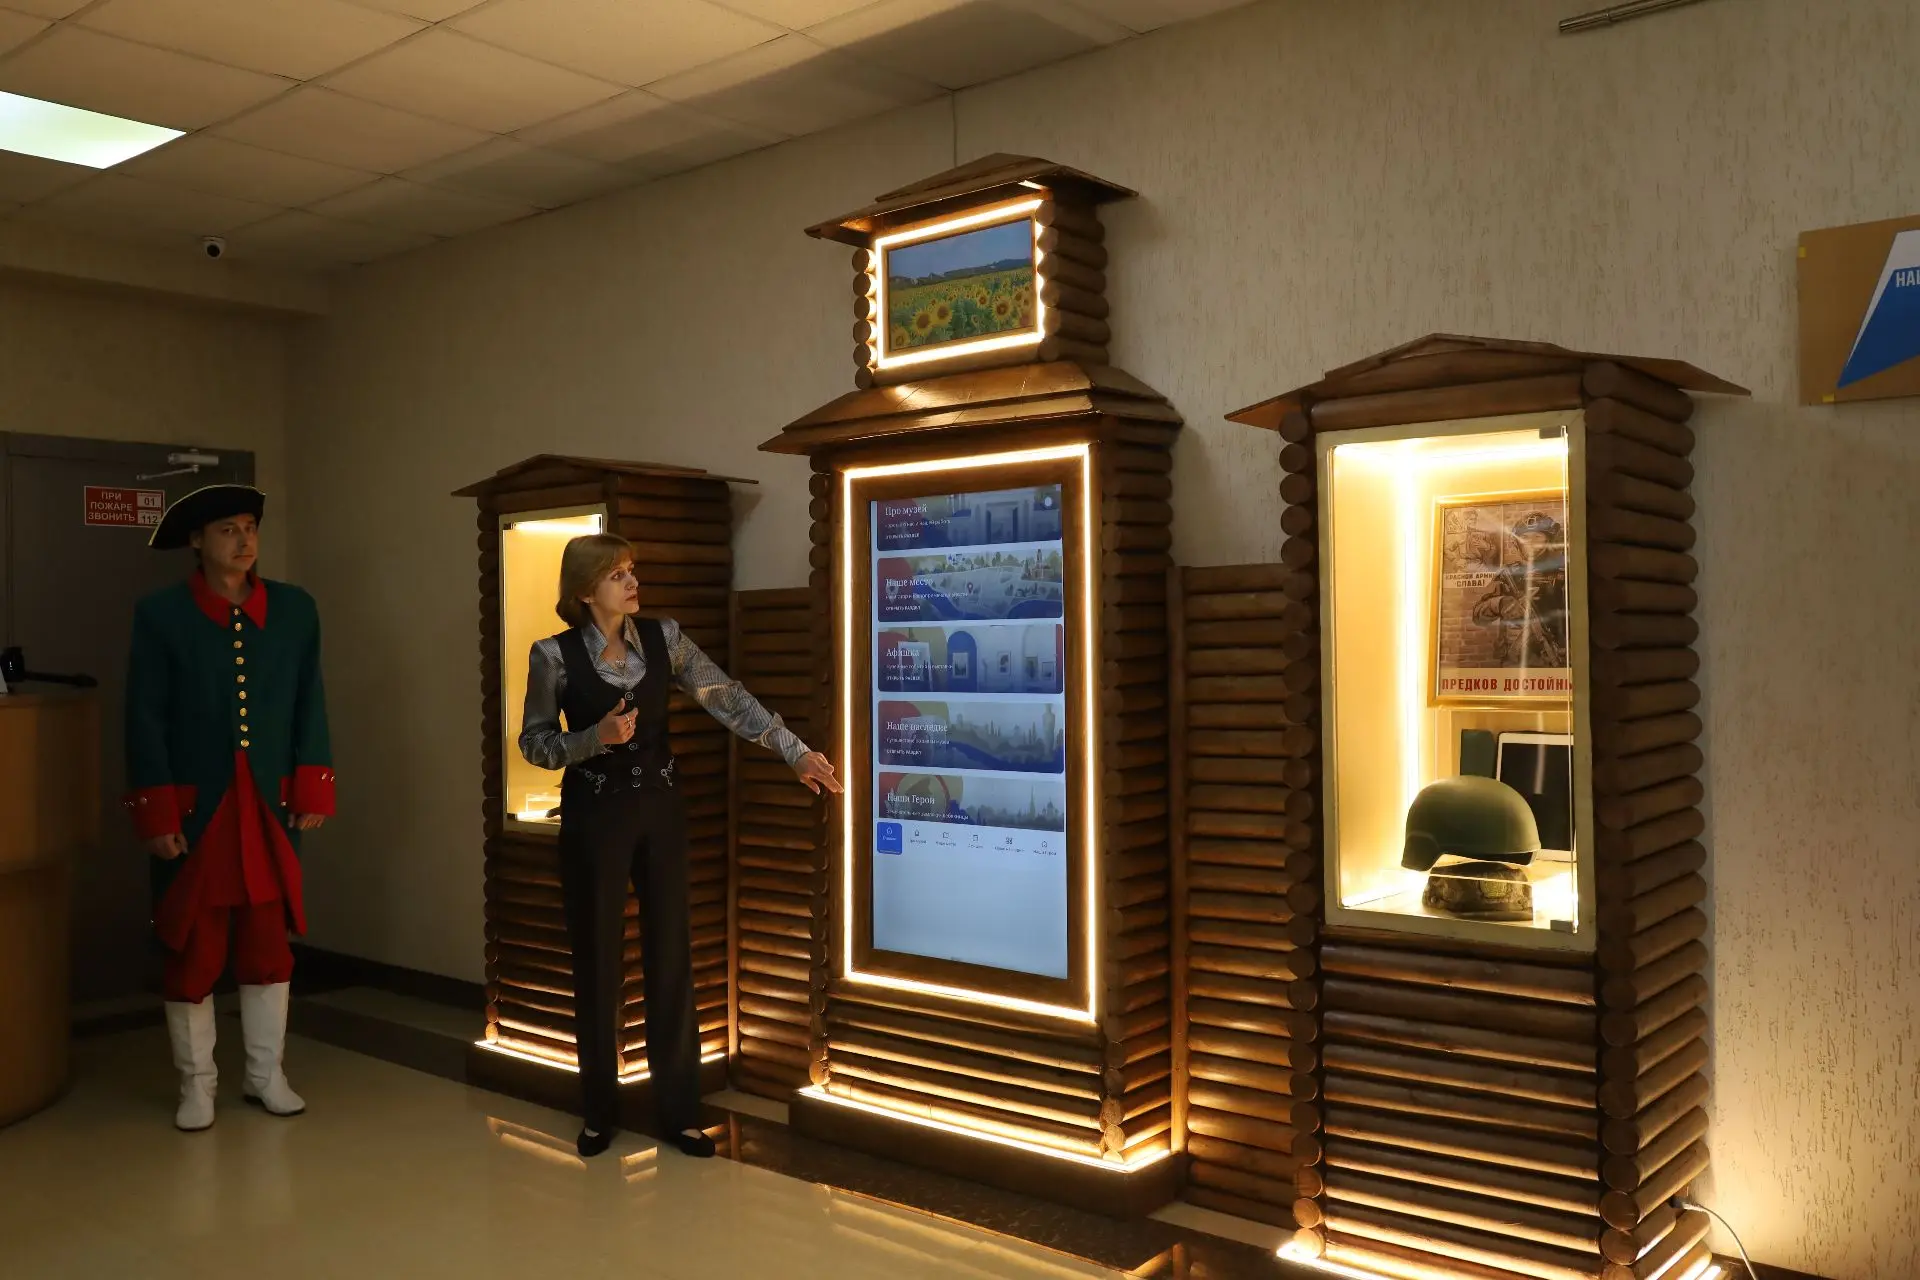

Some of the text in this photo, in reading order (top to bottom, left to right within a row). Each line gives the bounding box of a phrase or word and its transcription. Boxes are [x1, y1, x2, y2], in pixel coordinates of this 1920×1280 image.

[101, 491, 121, 501] ПРИ
[90, 501, 133, 511] ПОЖАРЕ
[144, 497, 155, 506] 01
[88, 512, 136, 522] ЗВОНИТЬ
[142, 515, 158, 524] 112
[886, 578, 908, 587] Наше
[1441, 678, 1498, 692] ПРЕДКОВ
[911, 794, 936, 806] Герои
